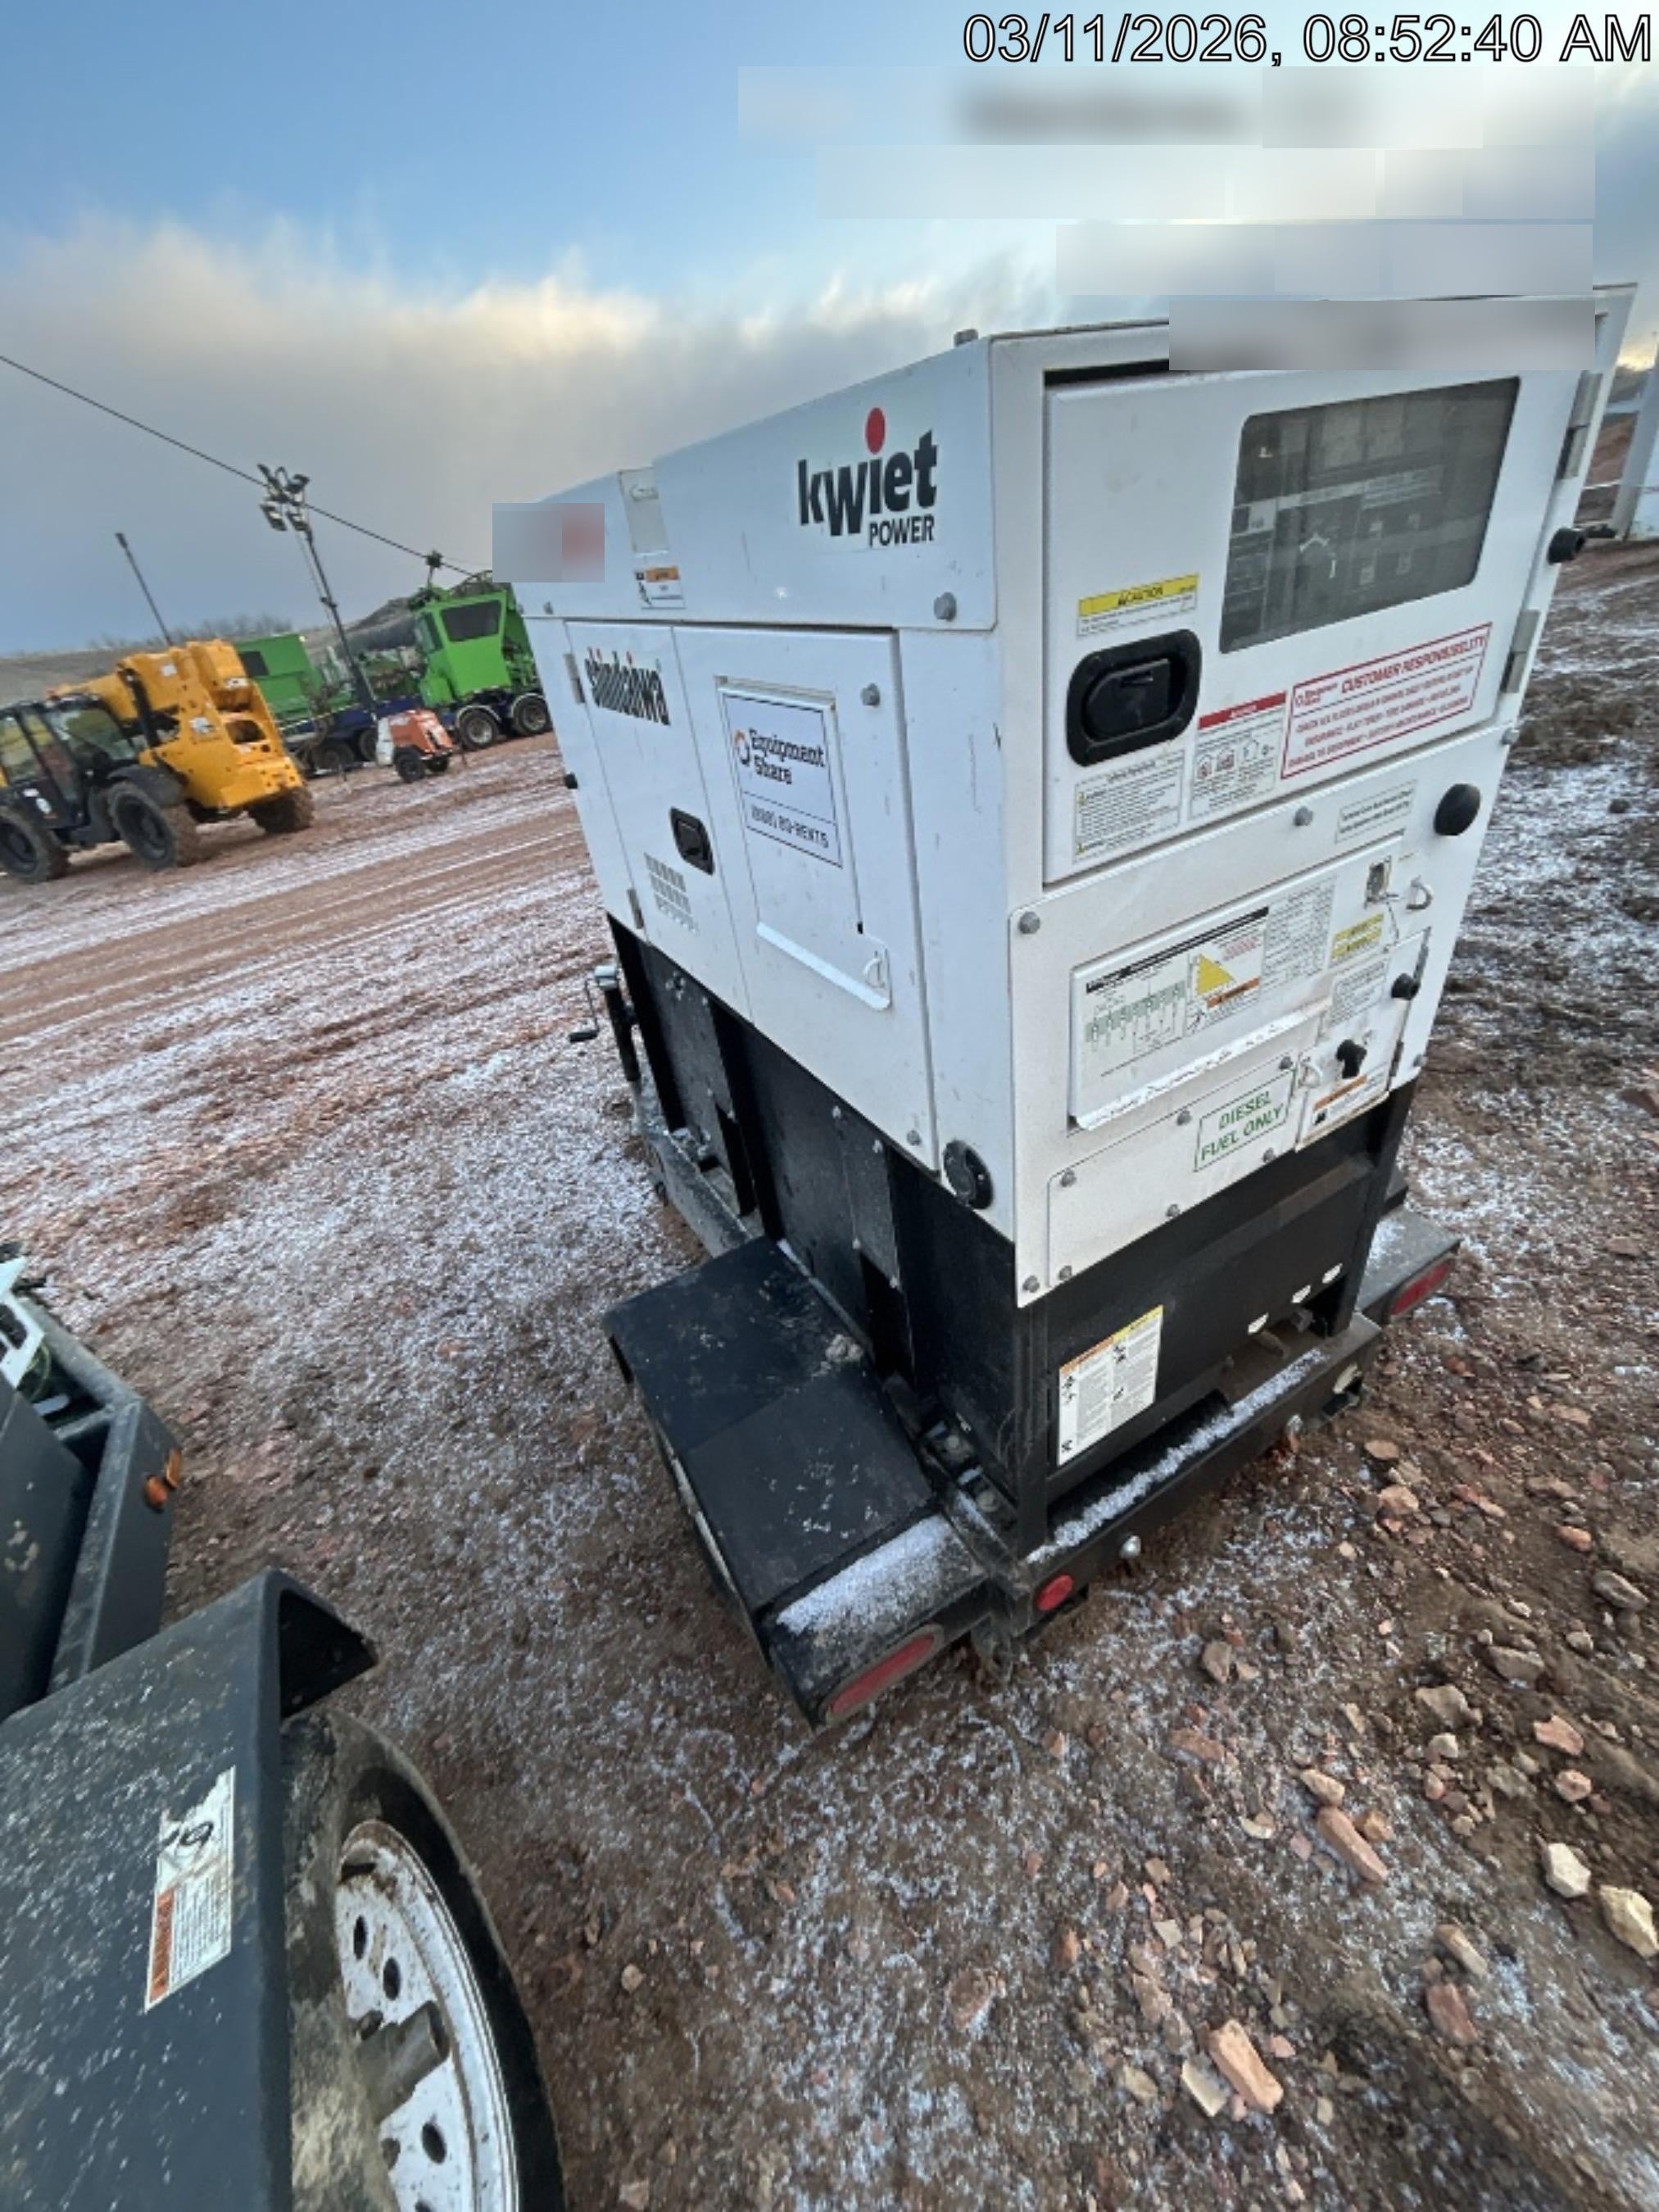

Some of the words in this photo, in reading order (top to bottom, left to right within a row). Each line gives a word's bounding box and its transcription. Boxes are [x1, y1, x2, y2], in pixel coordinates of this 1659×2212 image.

[798, 407, 938, 537] kwiet
[868, 514, 936, 548] POWER
[1342, 662, 1403, 694] CUSTOMER
[749, 728, 825, 768] Equipment
[754, 755, 792, 785] Share
[1219, 1090, 1272, 1131] DIESEL
[1201, 1131, 1240, 1162] FUEL
[1244, 1104, 1285, 1137] ONLY
